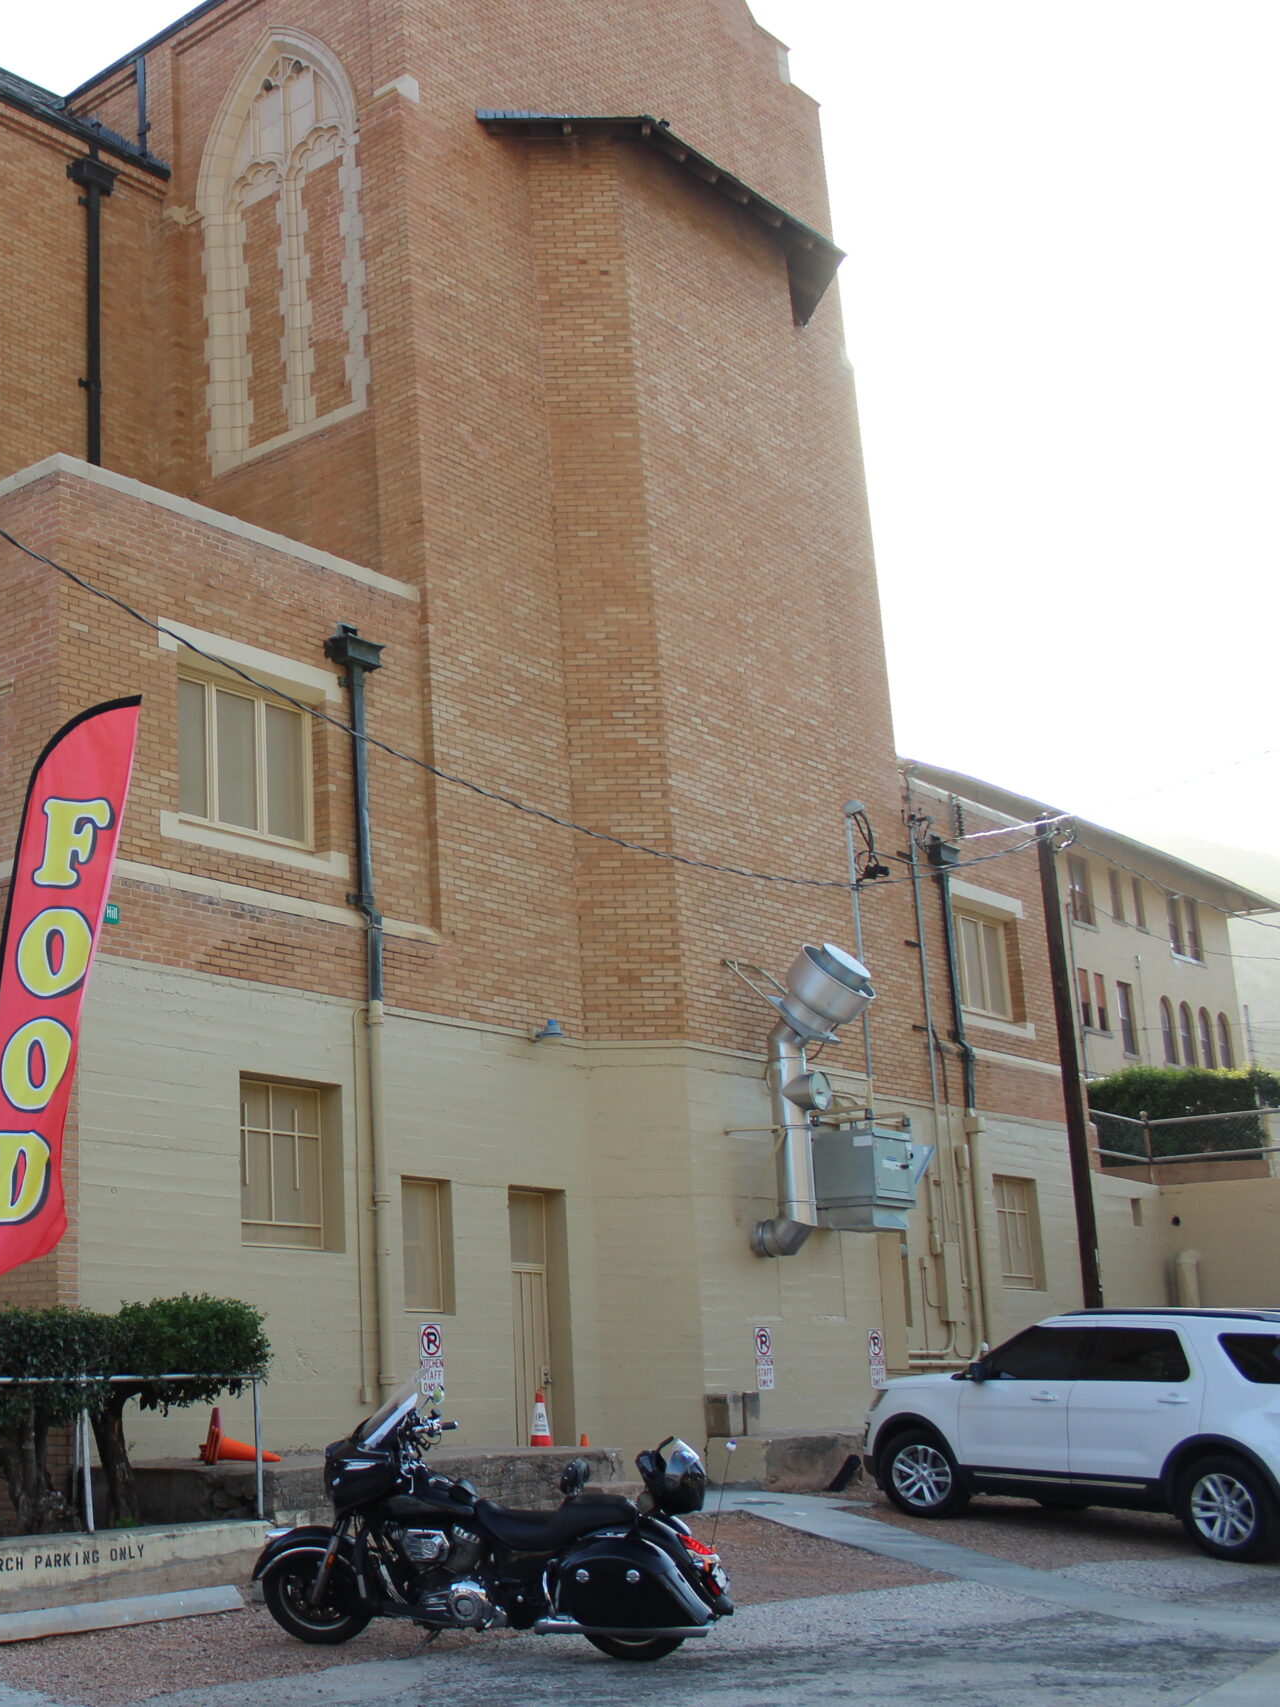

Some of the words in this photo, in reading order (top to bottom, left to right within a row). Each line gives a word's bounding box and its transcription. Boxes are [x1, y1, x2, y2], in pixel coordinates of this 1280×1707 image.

[106, 905, 118, 919] Hill
[420, 1359, 443, 1368] KITCHEN
[423, 1370, 442, 1380] STAFF
[34, 1550, 100, 1570] PARKING
[109, 1543, 145, 1563] ONLY
